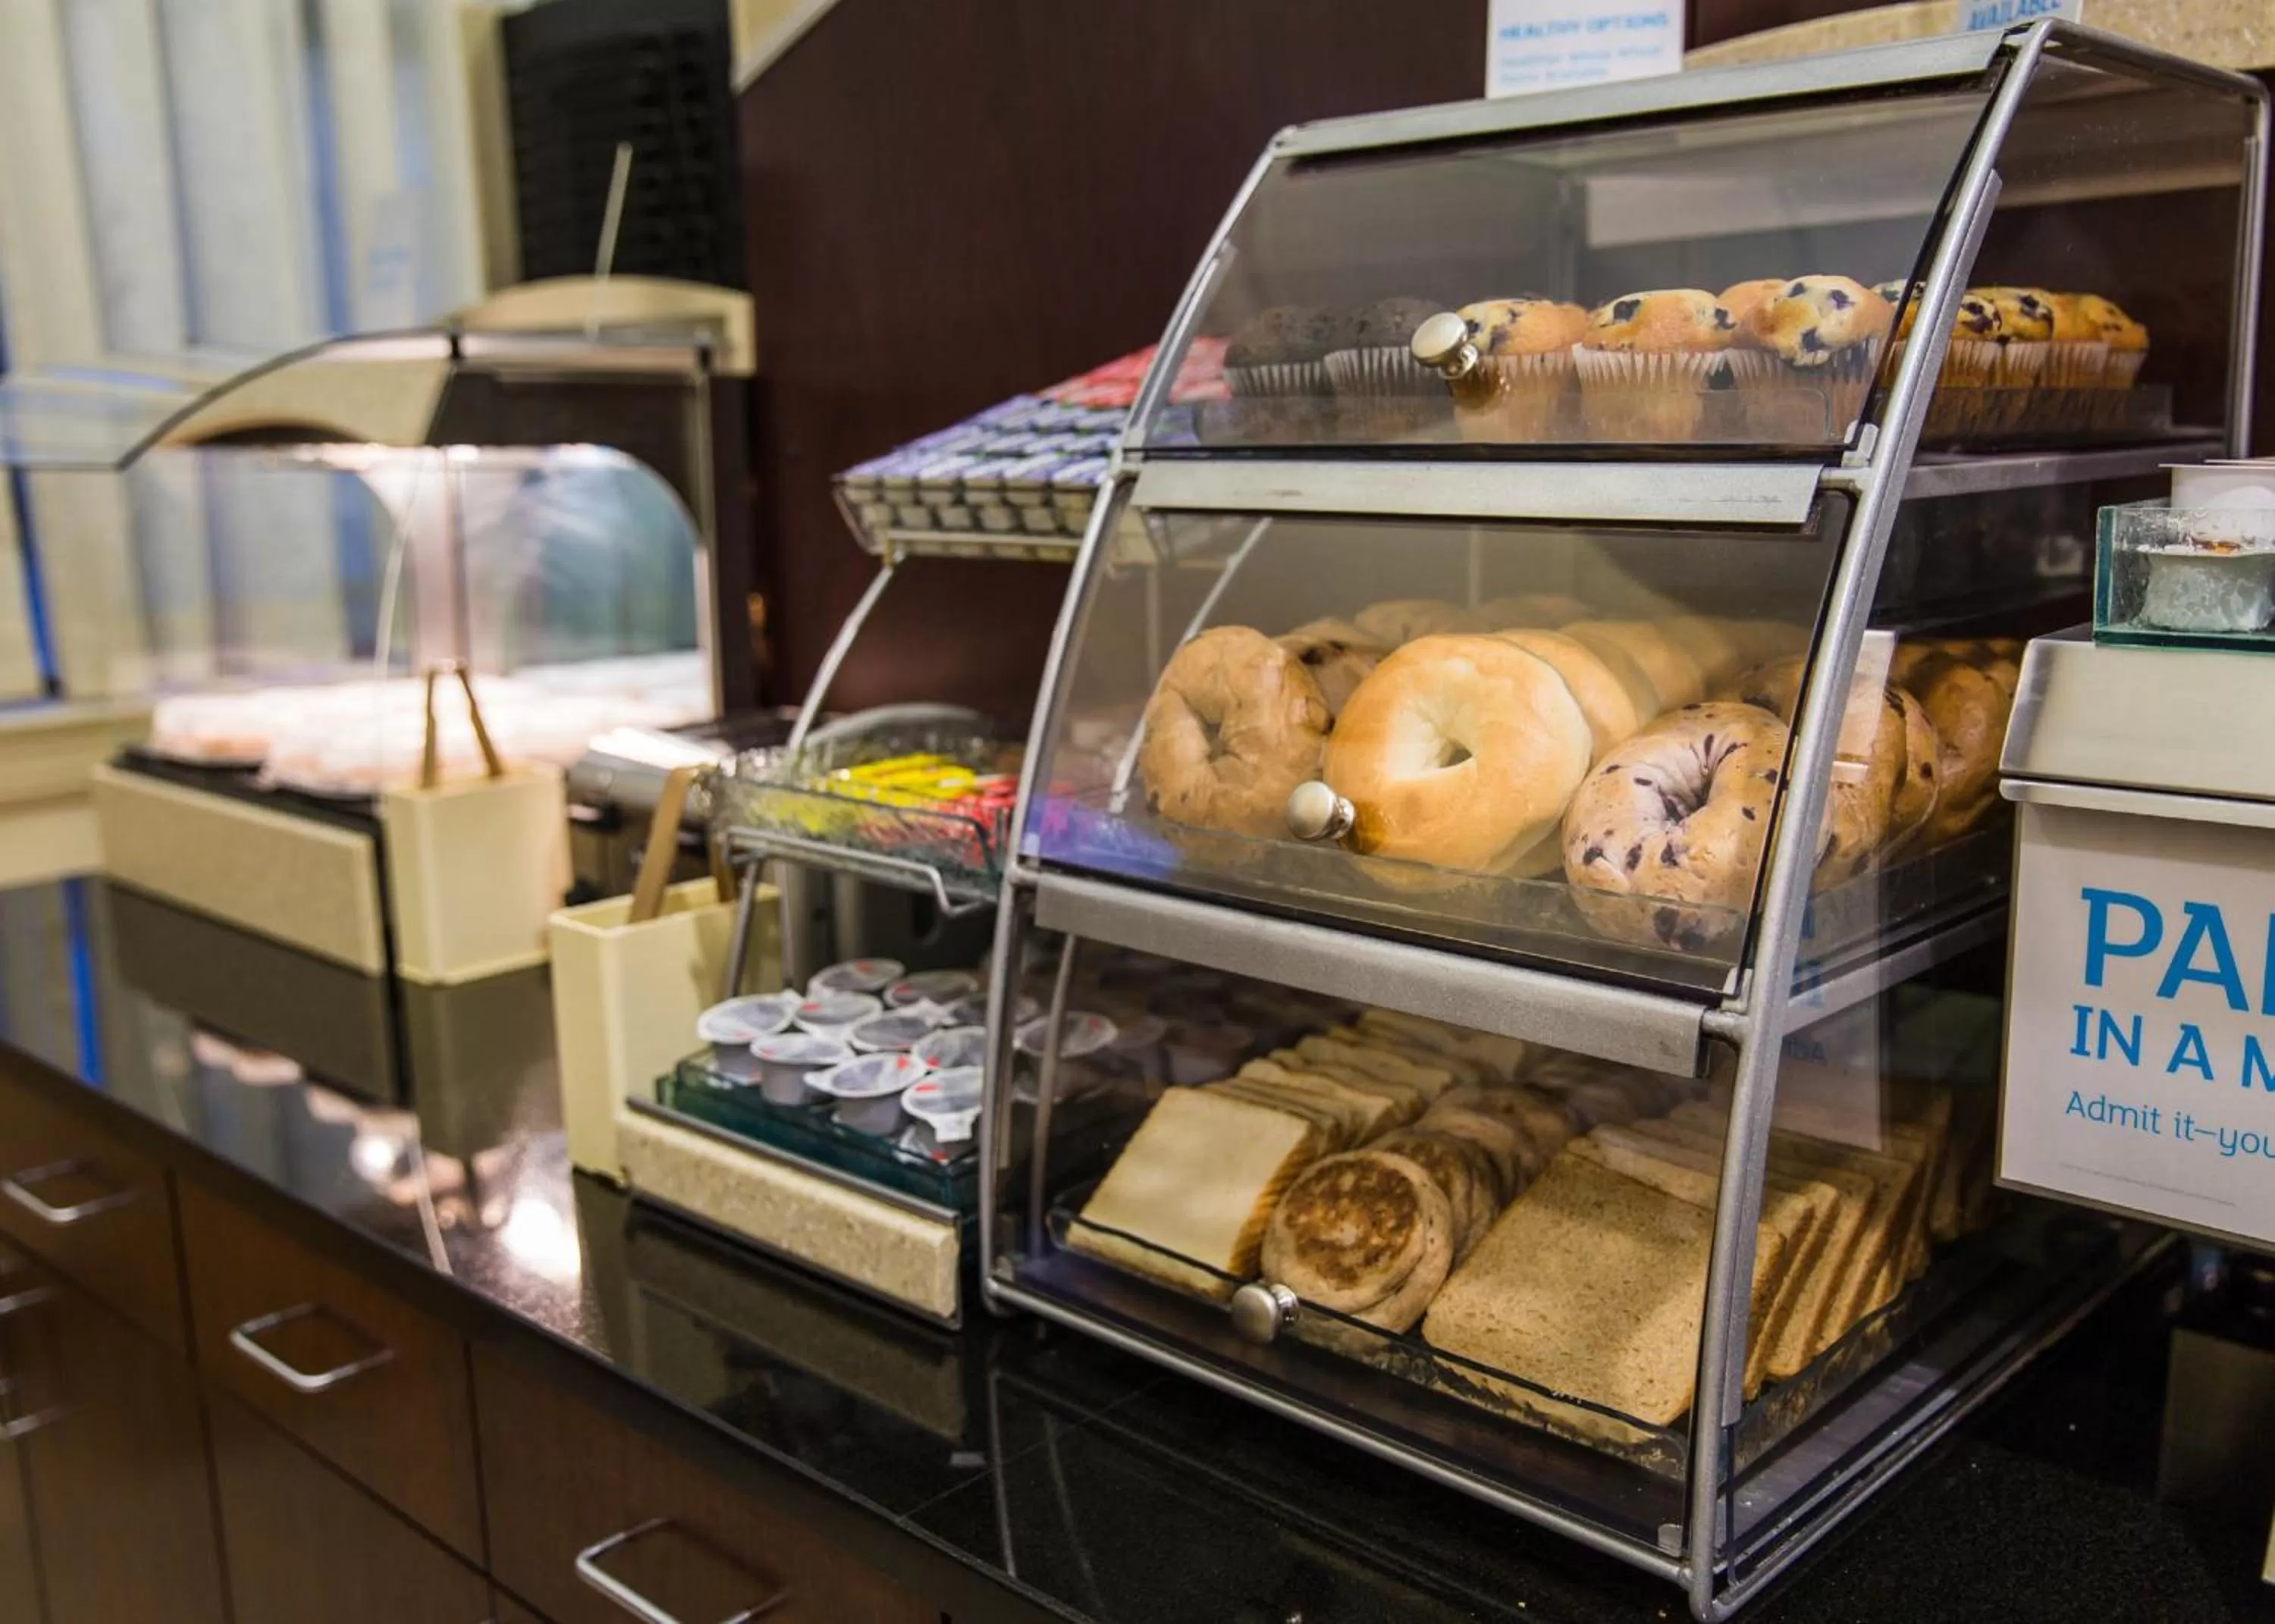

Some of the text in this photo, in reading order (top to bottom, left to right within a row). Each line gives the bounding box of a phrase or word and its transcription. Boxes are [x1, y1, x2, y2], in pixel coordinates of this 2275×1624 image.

[2080, 886, 2275, 1017] PA
[2069, 1004, 2143, 1068] IN
[2165, 1023, 2215, 1081] A
[2065, 1090, 2161, 1135] Admit
